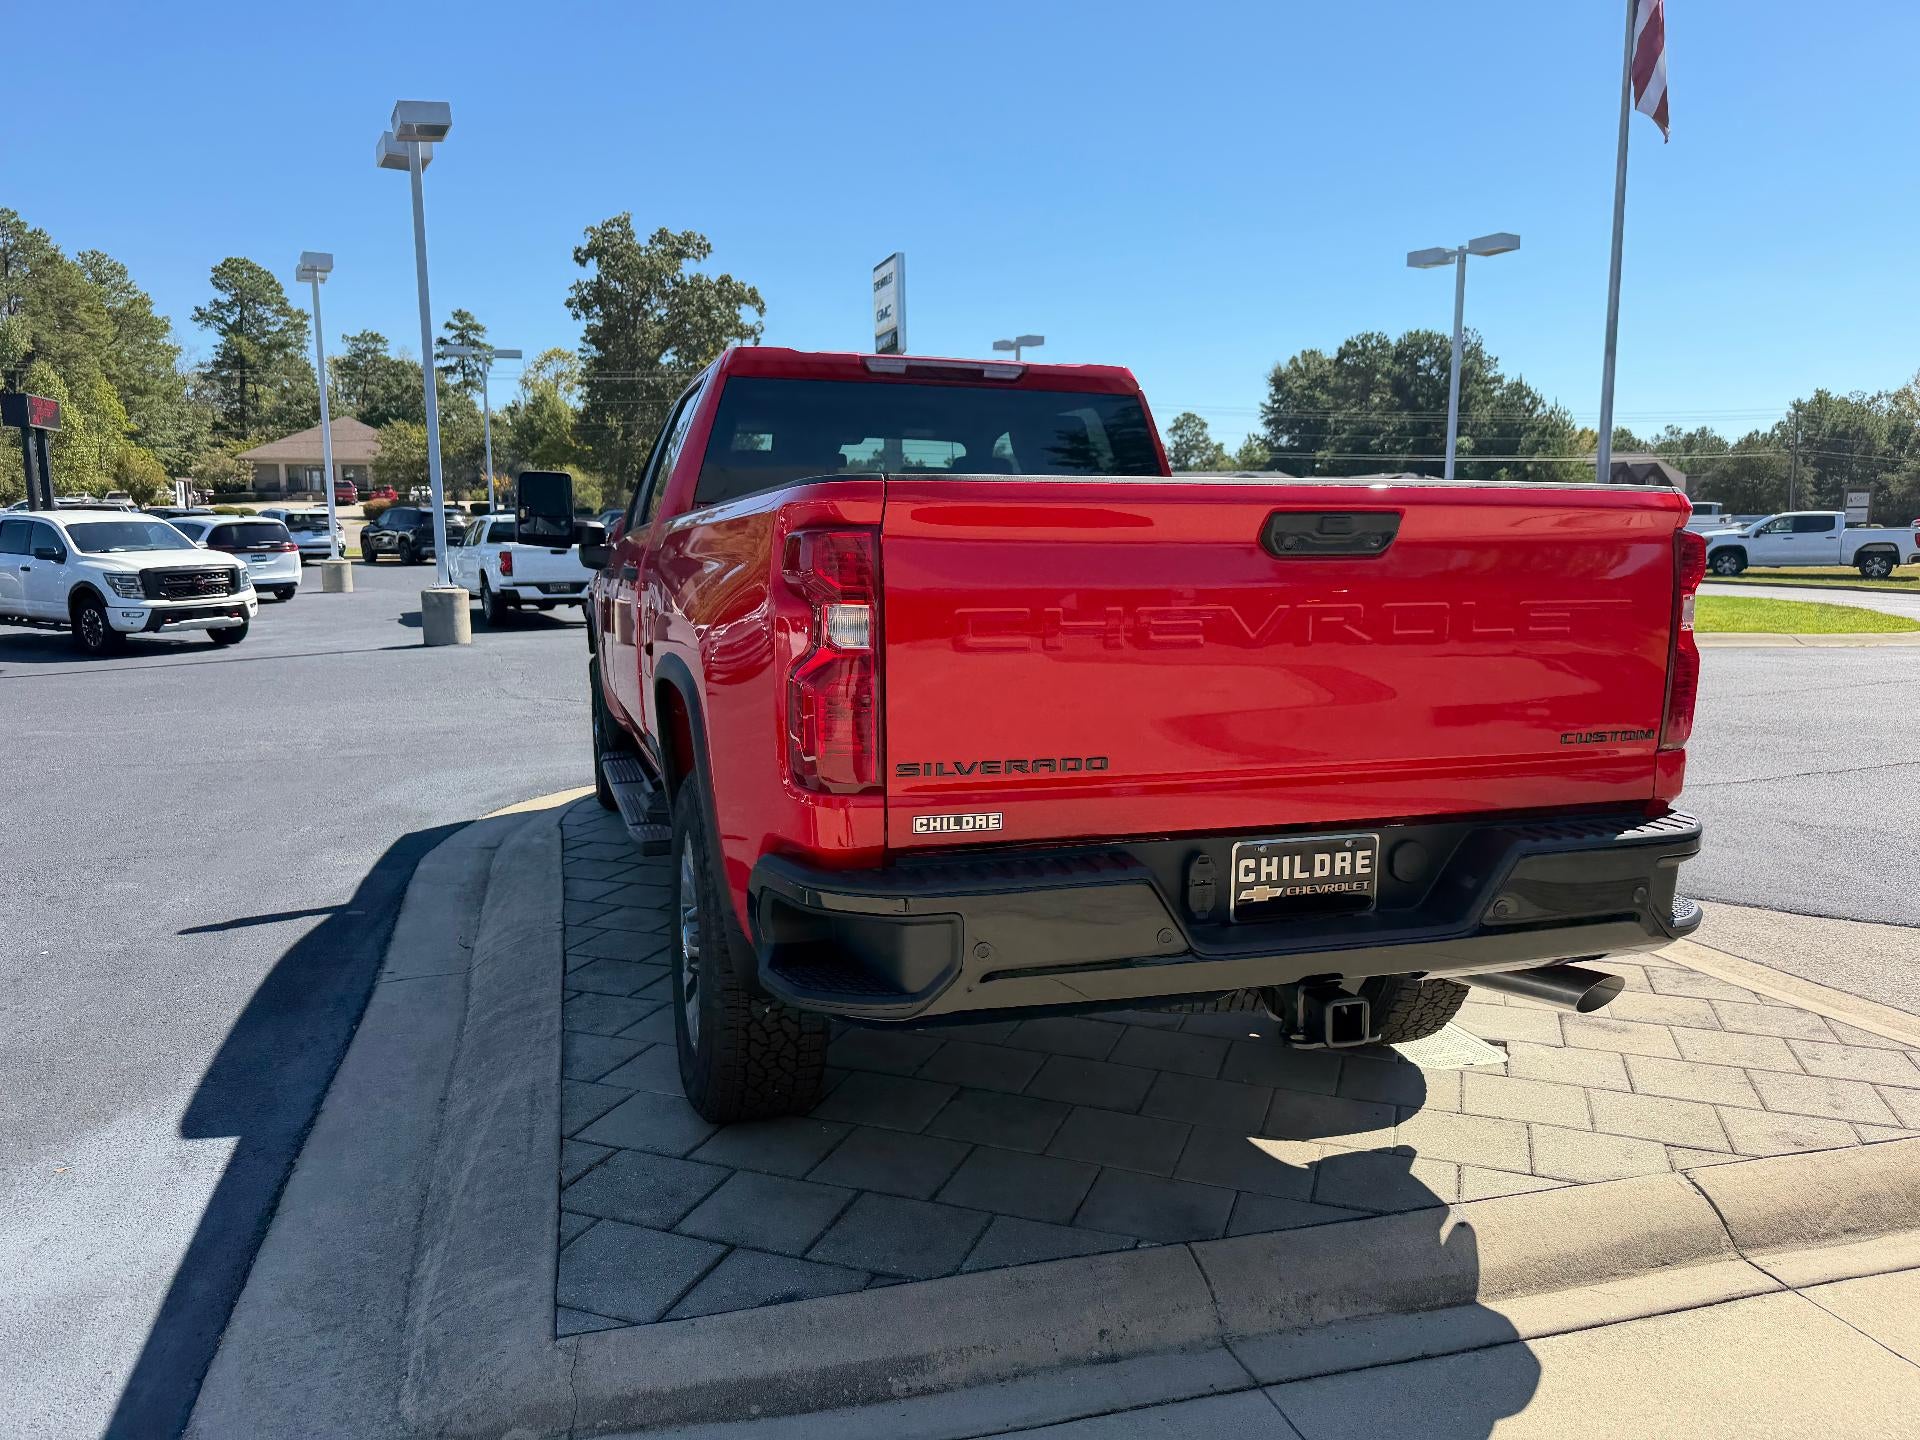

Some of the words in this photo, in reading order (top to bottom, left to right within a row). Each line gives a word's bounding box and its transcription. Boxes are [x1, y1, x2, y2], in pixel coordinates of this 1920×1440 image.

[876, 303, 892, 322] GMC
[1560, 729, 1655, 745] CUSTOM
[895, 756, 1109, 778] SILVERADO
[914, 814, 1000, 832] CHILDRE
[1237, 849, 1373, 883] CHILDRE
[1286, 880, 1371, 896] CHEVROLET
